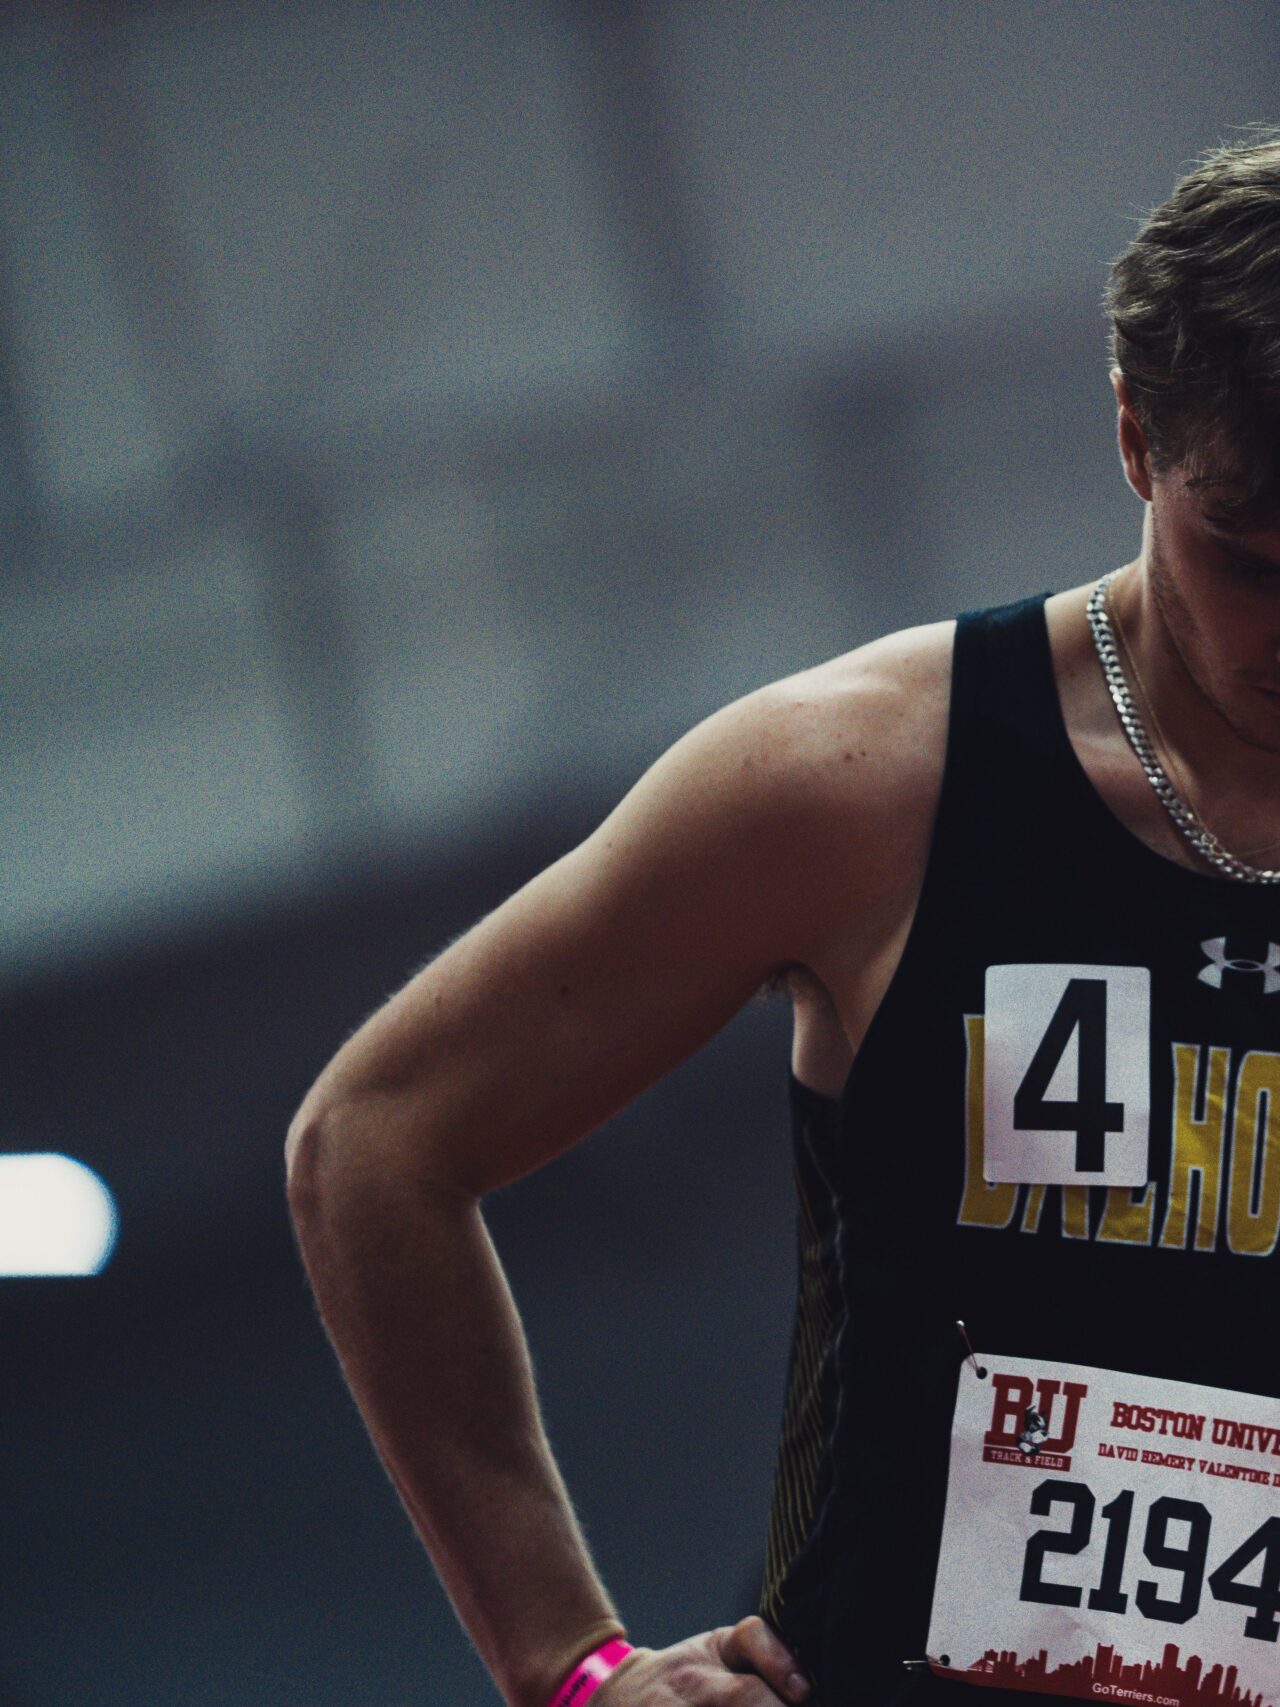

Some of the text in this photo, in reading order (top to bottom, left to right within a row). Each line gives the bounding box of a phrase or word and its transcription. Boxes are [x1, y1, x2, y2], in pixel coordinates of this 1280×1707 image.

[1013, 978, 1125, 1173] 4
[984, 1373, 1088, 1454] BU
[1110, 1401, 1206, 1441] BOSTON
[991, 1450, 1063, 1468] TRACK & FIELD
[1097, 1443, 1138, 1461] DAVID
[1141, 1449, 1195, 1471] HEMERY
[1199, 1459, 1270, 1485] VALENTINE
[1092, 1682, 1180, 1707] GoTerriers.com
